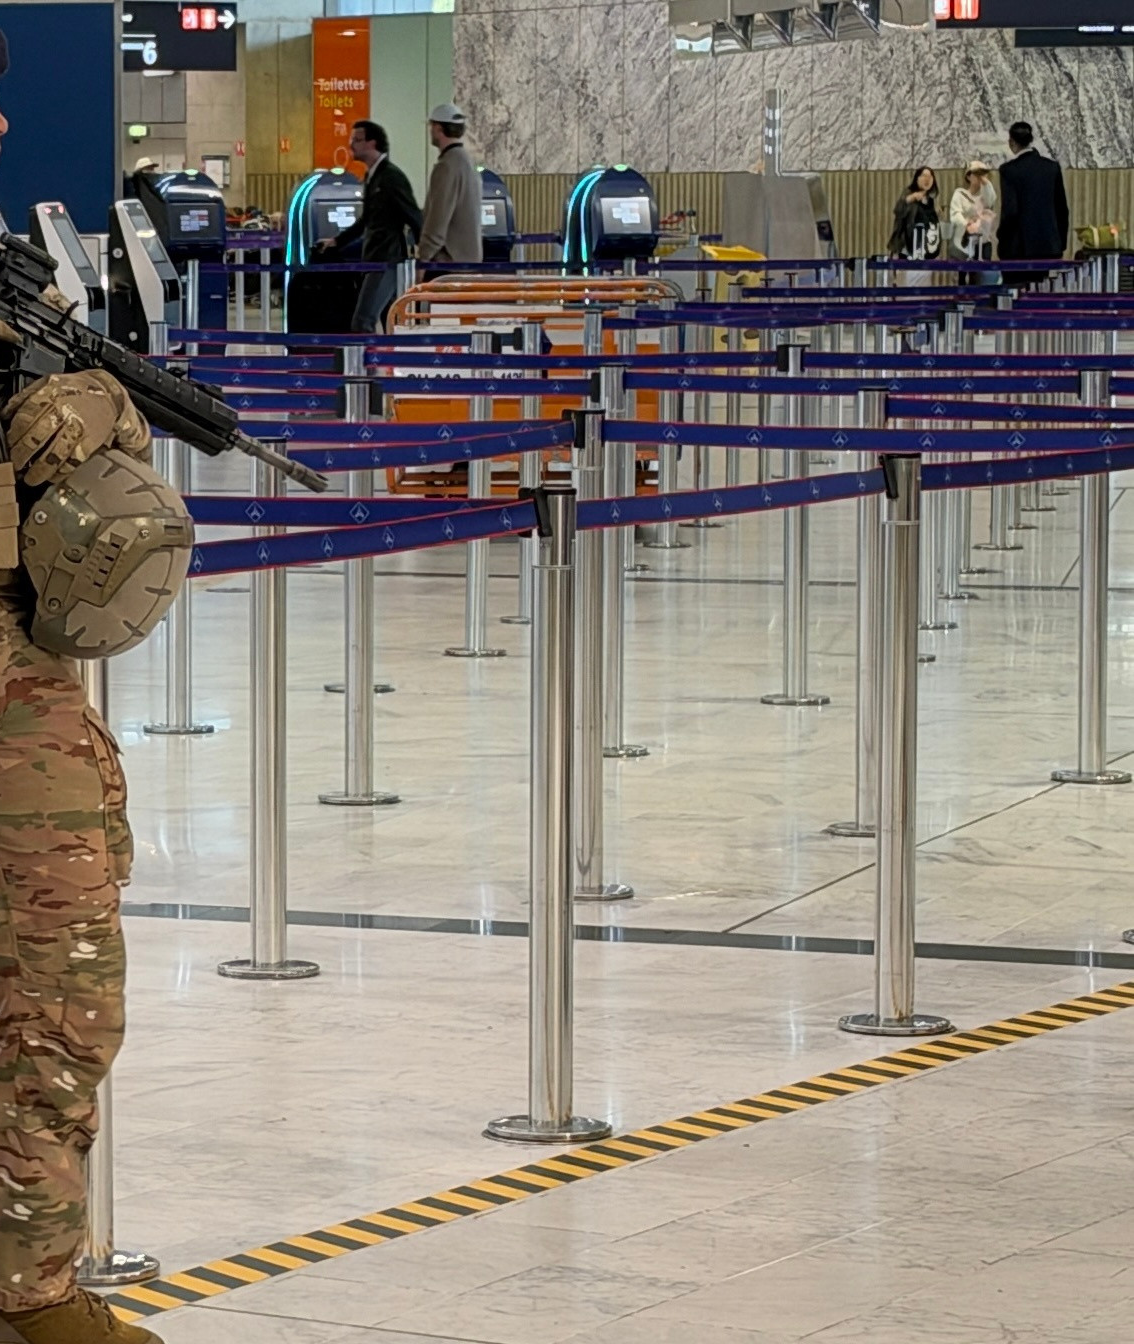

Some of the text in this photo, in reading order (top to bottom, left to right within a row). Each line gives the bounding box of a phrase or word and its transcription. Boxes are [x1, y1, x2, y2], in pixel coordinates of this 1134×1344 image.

[142, 40, 157, 65] 6
[318, 77, 365, 91] Toilettes
[318, 94, 354, 108] Toilets
